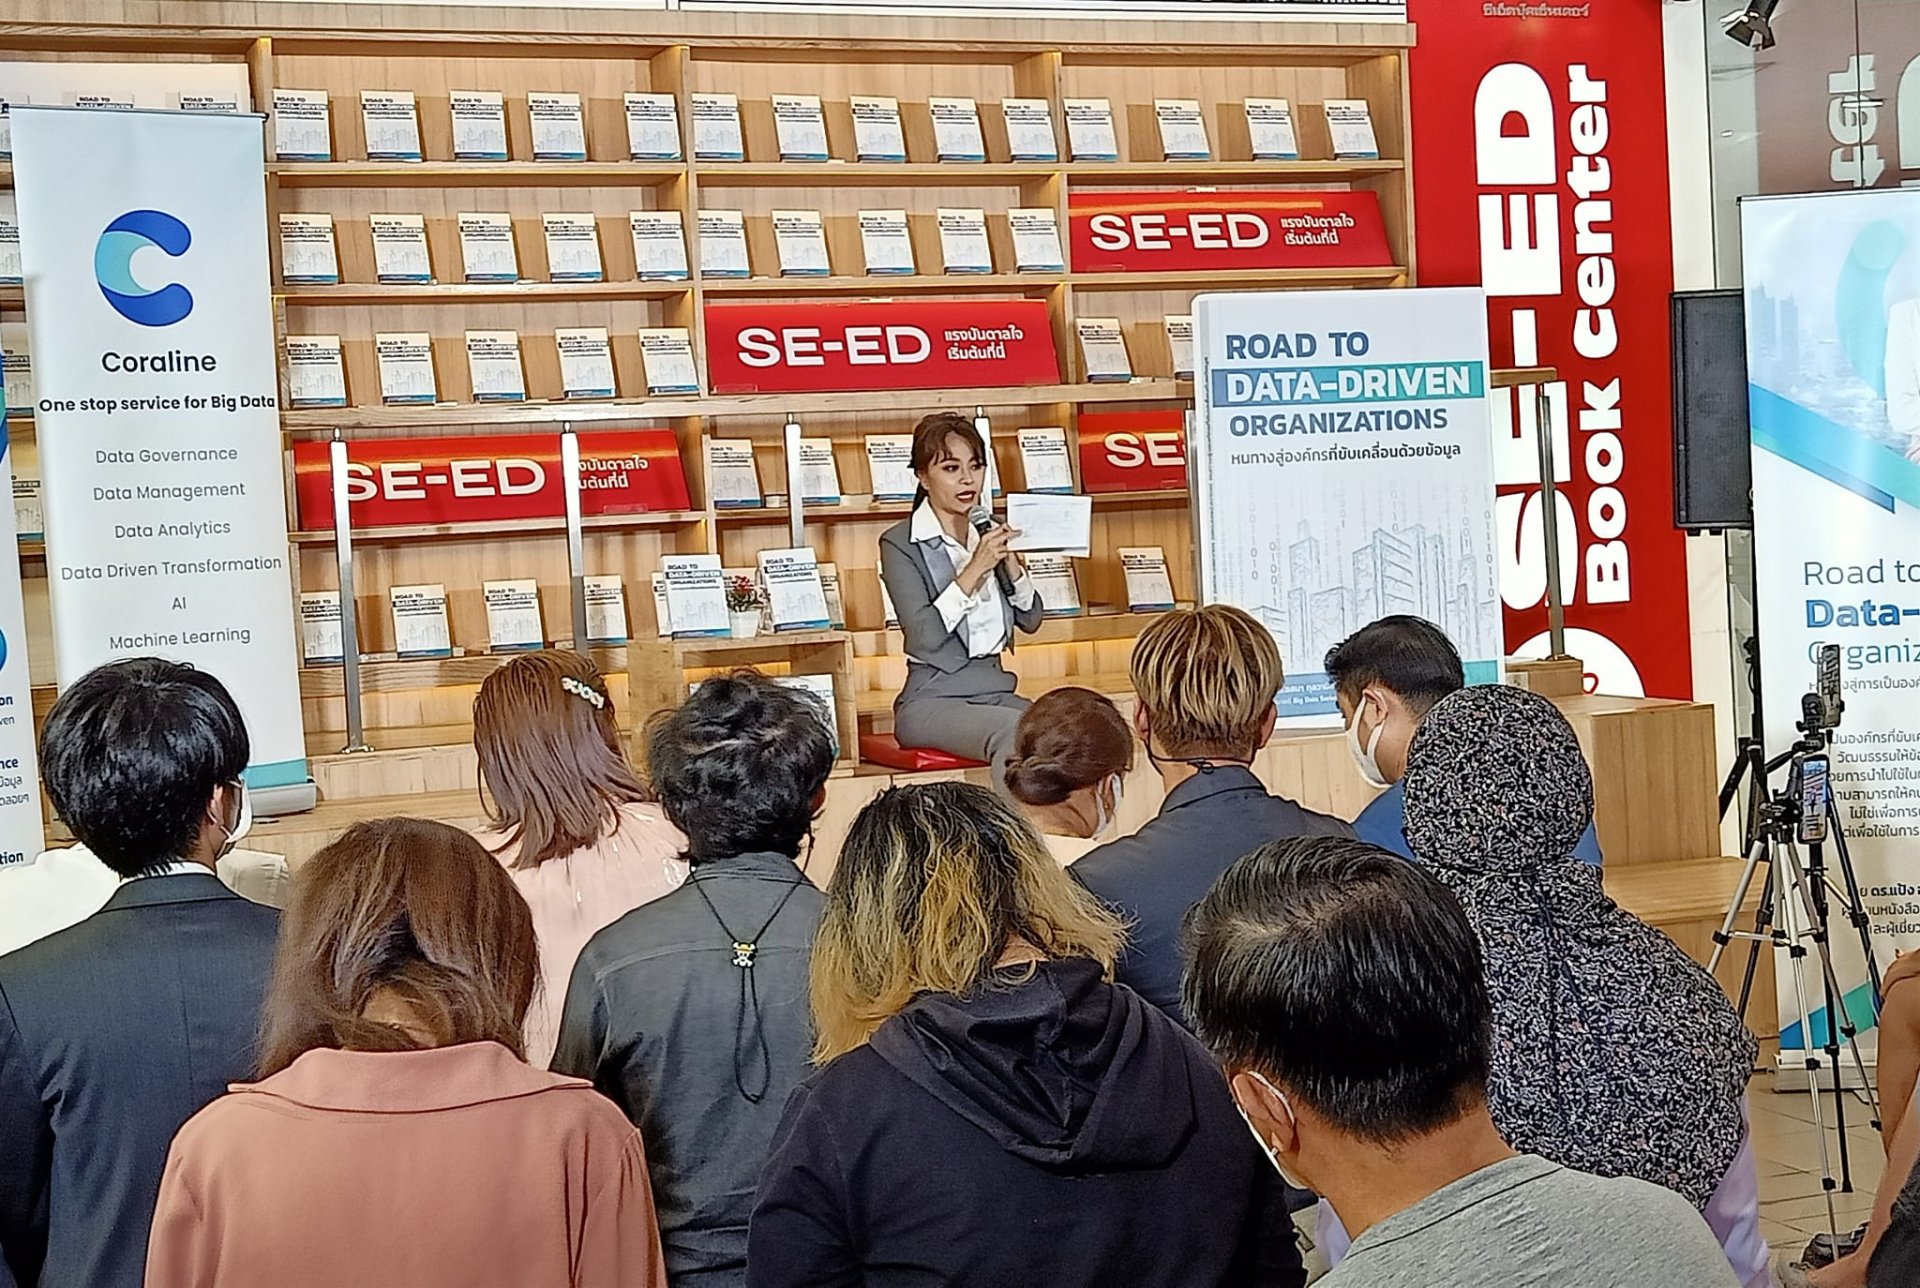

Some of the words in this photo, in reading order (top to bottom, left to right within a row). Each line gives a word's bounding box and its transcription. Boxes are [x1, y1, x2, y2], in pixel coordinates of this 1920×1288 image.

[1090, 214, 1269, 250] SE-ED
[738, 324, 932, 367] SE-ED
[1226, 332, 1317, 360] ROAD
[1329, 331, 1370, 358] TO
[101, 351, 216, 372] Coraline
[1226, 364, 1470, 403] DATA-DRIVEN
[39, 399, 75, 412] One
[80, 398, 117, 414] stop
[121, 396, 180, 410] service
[184, 395, 206, 409] for
[211, 394, 236, 412] Big
[241, 395, 275, 408] Data
[1229, 408, 1448, 438] ORGANIZATIONS
[96, 450, 134, 464] Data
[139, 448, 238, 462] Governance
[347, 458, 546, 501] SE-ED
[93, 486, 132, 500] Data
[136, 483, 245, 501] Management
[115, 524, 153, 538] Data
[158, 521, 231, 539] Analytics
[62, 566, 102, 580] Data
[107, 562, 158, 577] Driven
[162, 556, 281, 576] Transformation
[1804, 558, 1884, 585] Road
[1894, 560, 1920, 583] to
[172, 597, 186, 610] AI
[110, 633, 178, 650] Machine
[183, 628, 250, 646] Learning
